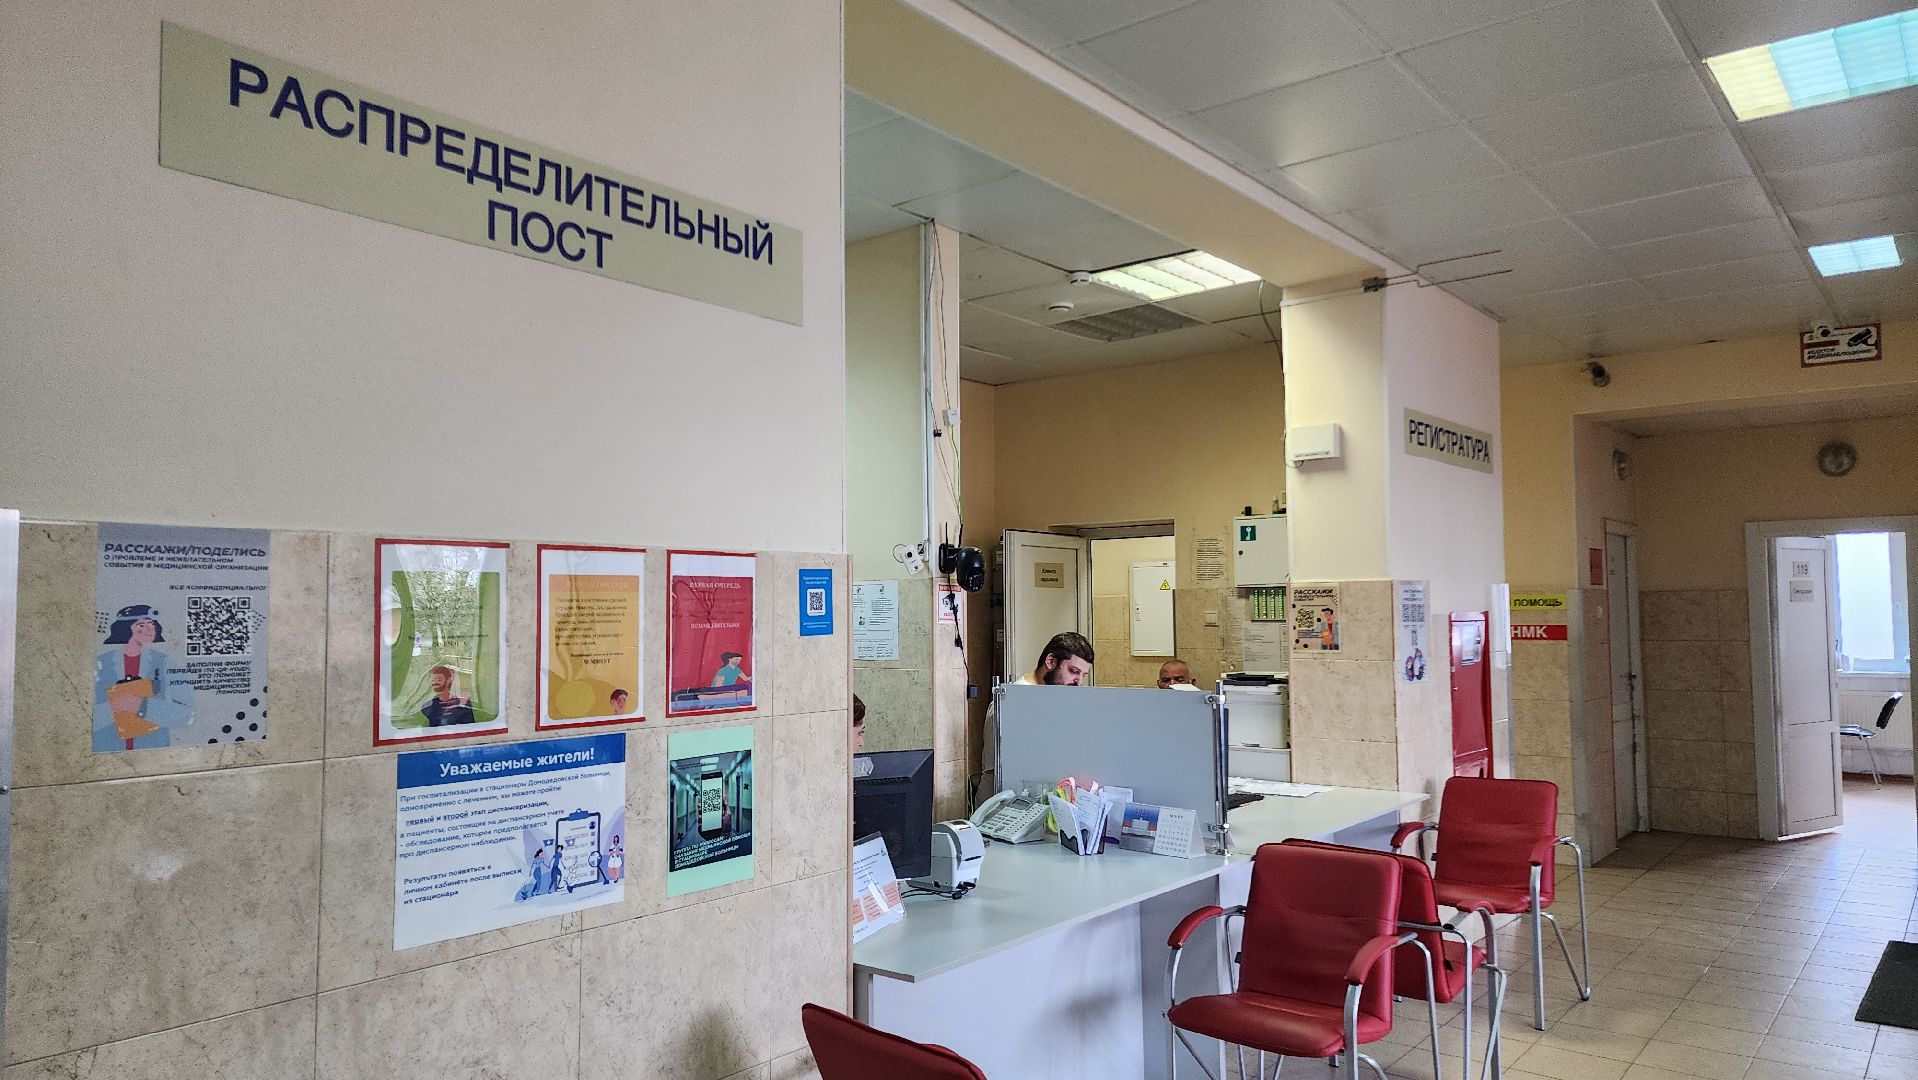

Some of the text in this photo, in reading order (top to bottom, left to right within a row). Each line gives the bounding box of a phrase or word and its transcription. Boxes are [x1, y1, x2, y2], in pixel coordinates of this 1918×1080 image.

[229, 58, 774, 265] РАСПРЕДЕЛИТЕЛЬНЫЙ
[487, 200, 614, 269] ПОСТ
[1409, 419, 1491, 464] РЕГИСТРАТУРА
[104, 543, 266, 557] РАССКАЖИ/ПОДЕЛИСЬ
[153, 562, 213, 570] МЕДИЦИНСКОЙ
[1514, 598, 1562, 607] ПОМОЩЬ
[440, 747, 595, 778] Уважаемые жители!
[400, 794, 416, 803] При
[417, 788, 478, 800] госпитализации
[485, 782, 527, 792] стационары
[528, 774, 579, 787] Домодедовской
[400, 801, 456, 812] одновременно
[463, 795, 499, 805] лечением,
[405, 816, 434, 826] первый
[443, 811, 469, 821] второй
[470, 809, 487, 817] этап
[447, 821, 486, 831] состоящие
[497, 813, 546, 825] диспансерном
[462, 829, 492, 839] которое
[494, 821, 548, 835] предполагается
[416, 843, 470, 857] диспансерном
[403, 872, 447, 885] Результаты
[403, 868, 522, 895] личном кабинете после выписки
[414, 890, 459, 903] стационара
